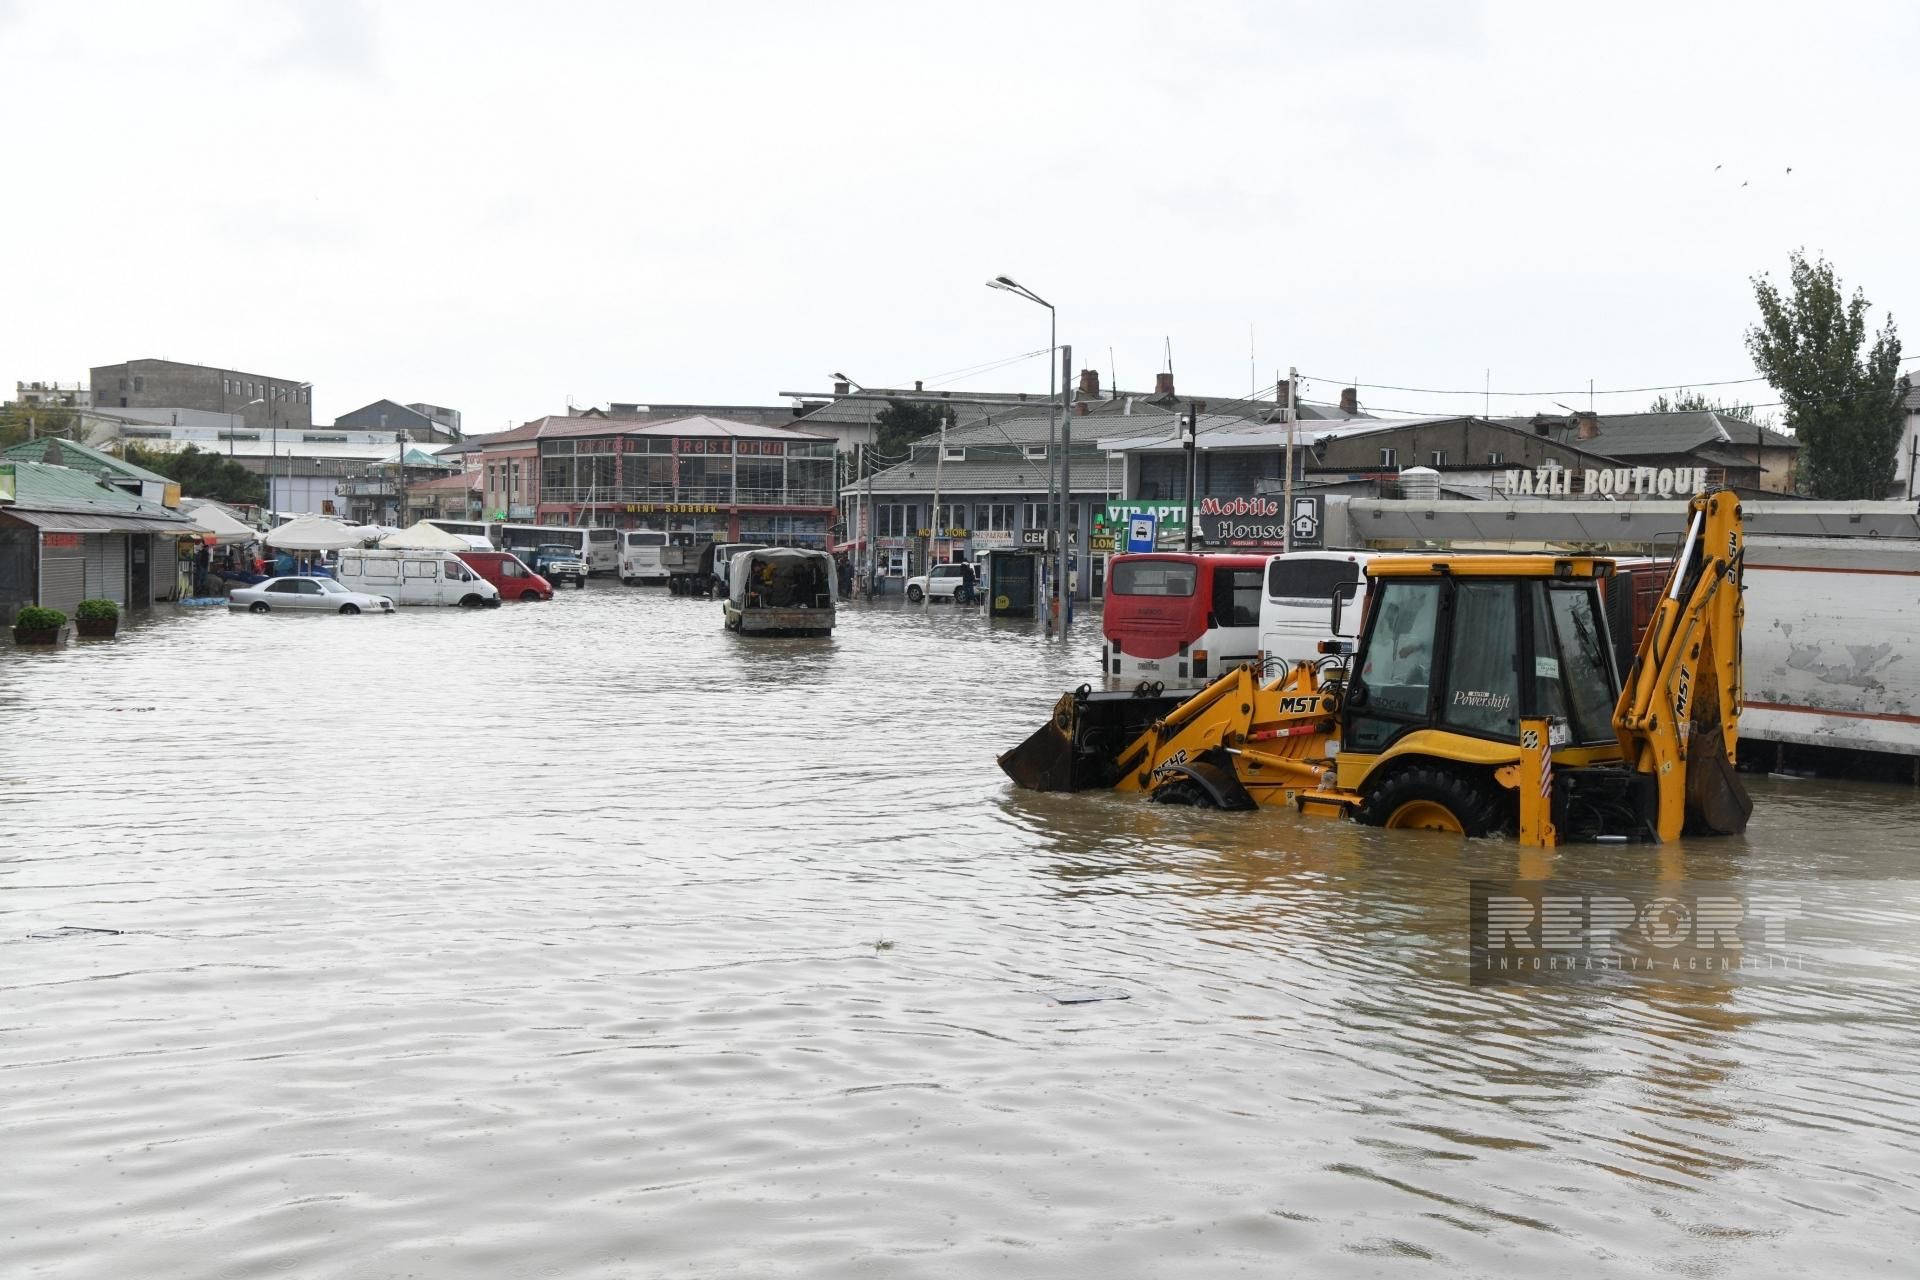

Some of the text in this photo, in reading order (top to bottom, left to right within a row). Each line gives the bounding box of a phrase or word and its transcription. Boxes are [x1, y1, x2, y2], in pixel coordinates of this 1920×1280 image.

[1584, 467, 1707, 499] BOUTIQUE
[627, 504, 654, 513] MINI
[1200, 496, 1279, 517] Mobile
[945, 528, 967, 537] STORE
[1218, 521, 1287, 539] House
[1675, 663, 1690, 718] MST
[1279, 696, 1321, 713] MST
[1452, 691, 1510, 712] Powershift
